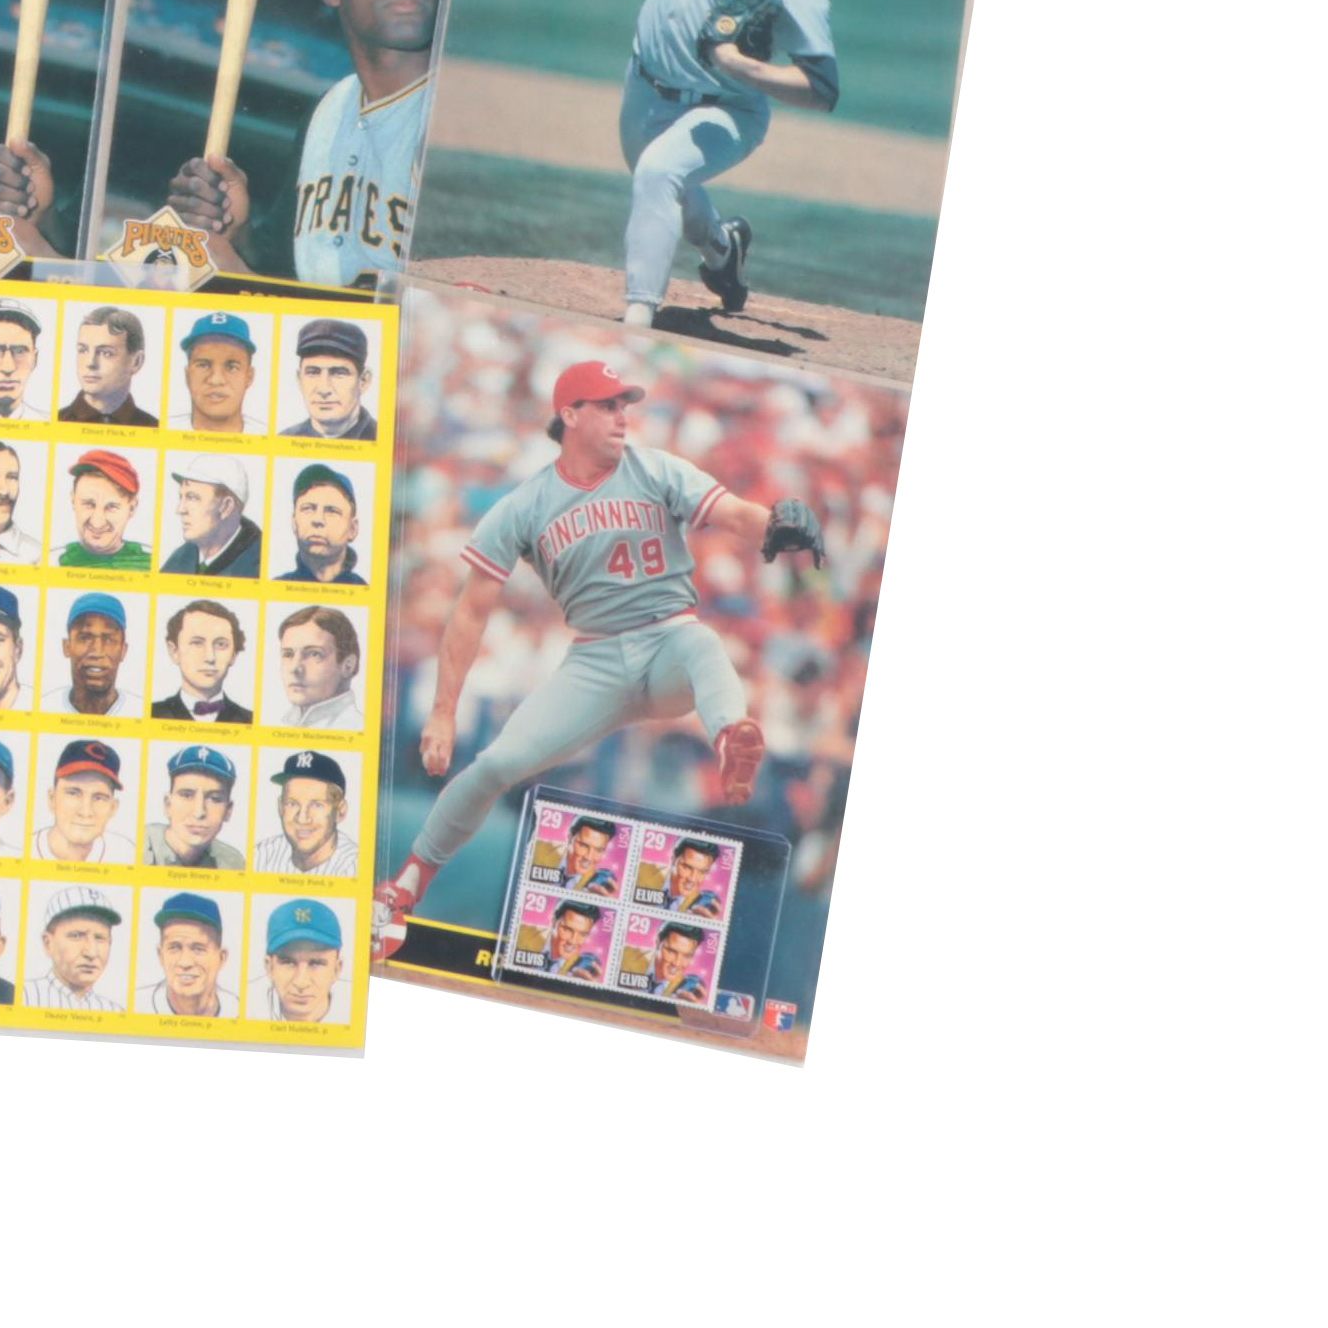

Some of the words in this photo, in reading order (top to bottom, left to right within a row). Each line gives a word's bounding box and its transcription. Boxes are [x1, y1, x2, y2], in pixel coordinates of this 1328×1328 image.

[122, 219, 209, 268] PIRATES
[539, 499, 667, 567] CINCINNATI
[605, 537, 668, 578] 49
[541, 809, 563, 829] 29
[617, 827, 632, 849] USA
[644, 831, 666, 851] 29
[721, 848, 735, 871] USA
[531, 866, 560, 883] ELVIS
[524, 892, 547, 913] 29
[634, 888, 664, 904] ELVIS
[602, 910, 616, 932] USA
[629, 913, 651, 934] 29
[705, 932, 719, 954] USA
[515, 951, 545, 967] ELVIS
[619, 973, 649, 990] ELVIS
